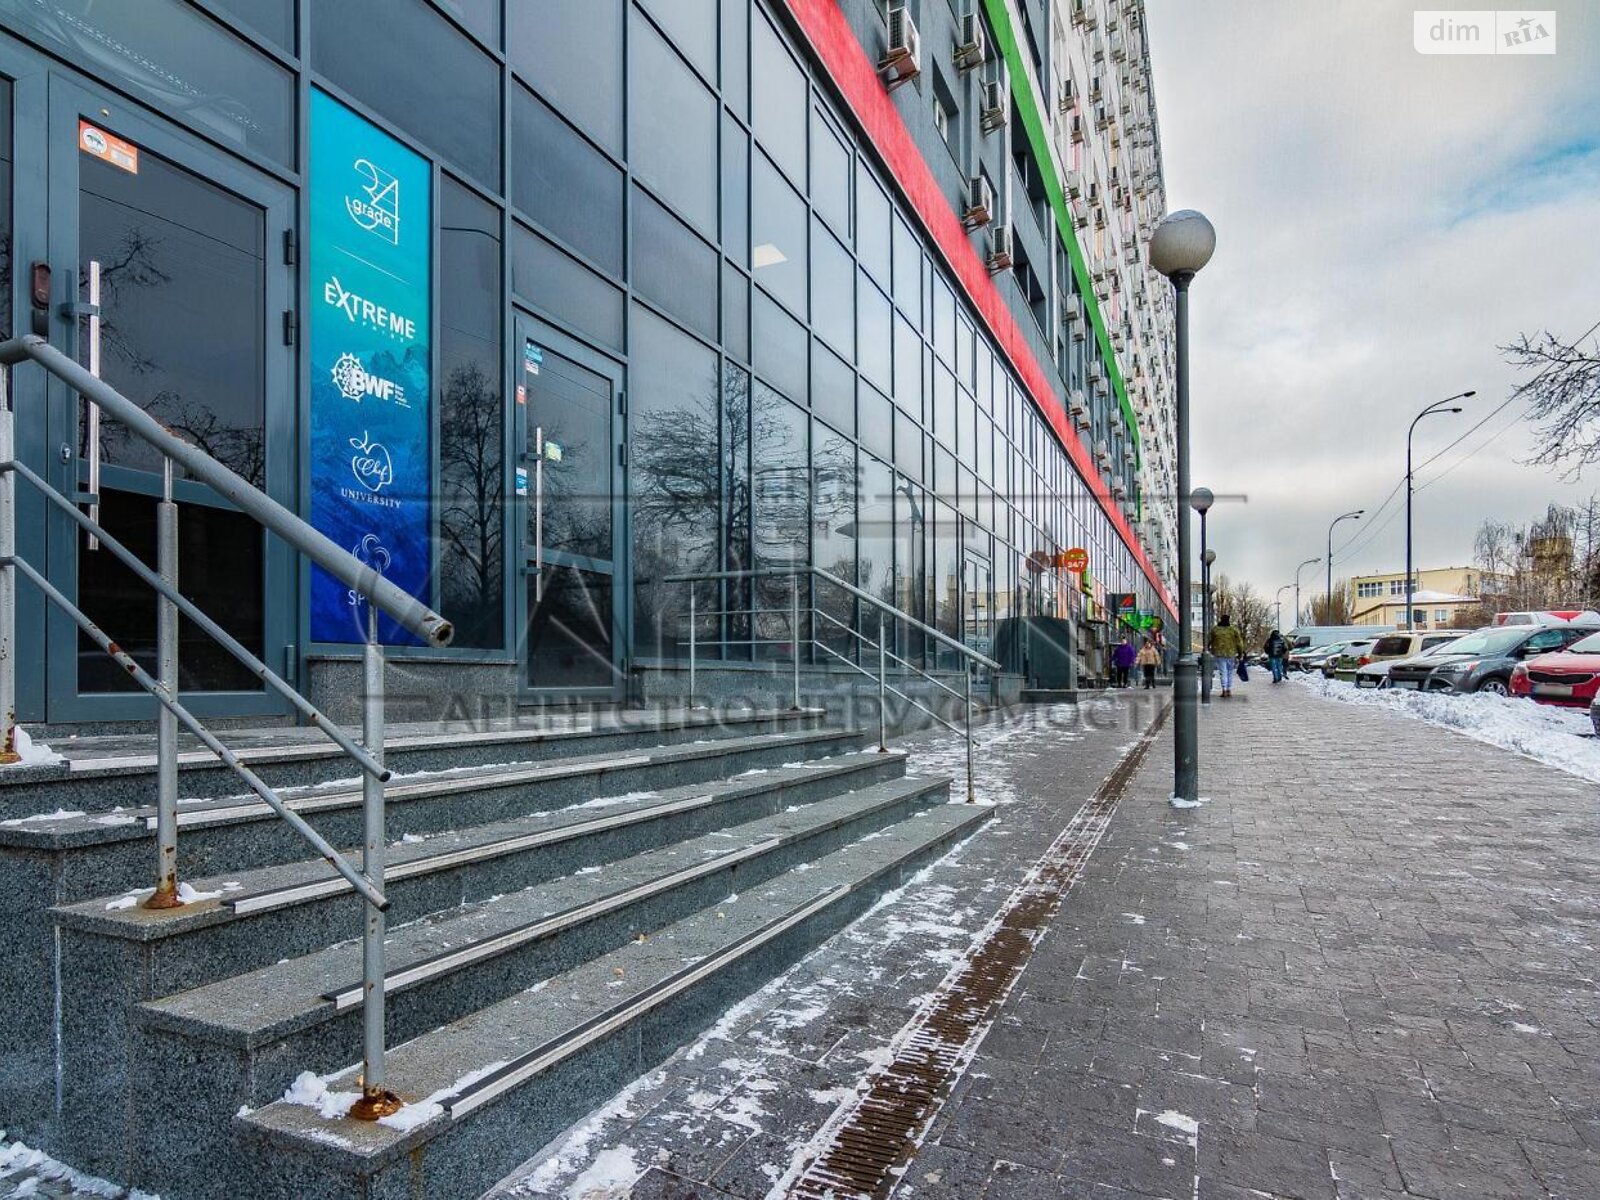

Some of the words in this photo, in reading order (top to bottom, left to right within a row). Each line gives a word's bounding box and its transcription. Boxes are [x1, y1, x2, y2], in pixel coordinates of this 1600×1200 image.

[352, 198, 392, 229] grade
[324, 275, 416, 340] EXTREME
[350, 367, 395, 401] BWF
[340, 487, 402, 509] UNIVERSITY
